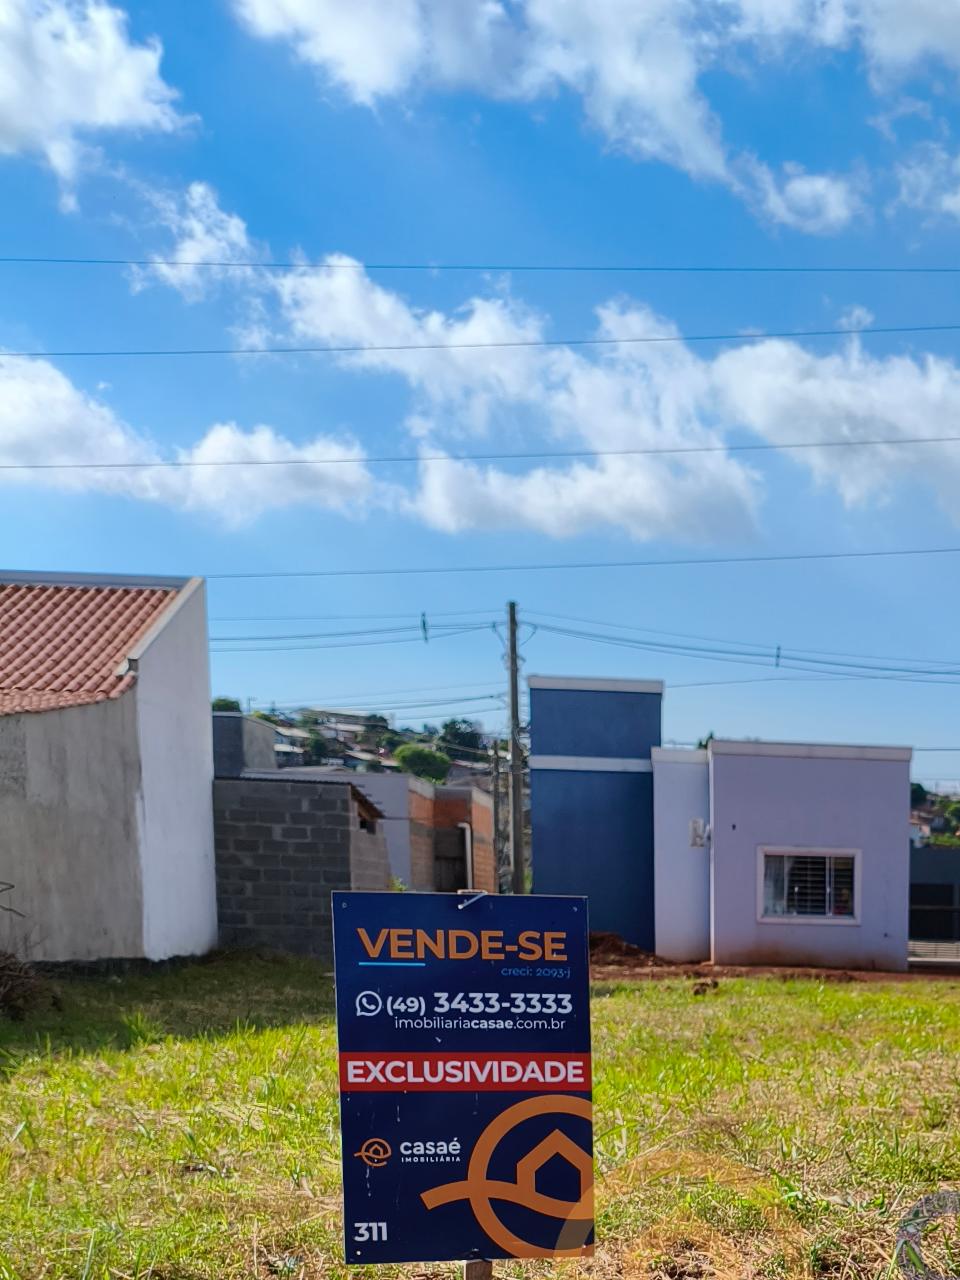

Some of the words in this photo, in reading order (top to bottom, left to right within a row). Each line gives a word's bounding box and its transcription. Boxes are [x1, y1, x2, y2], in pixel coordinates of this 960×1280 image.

[357, 927, 568, 961] VENDE-SE
[386, 996, 426, 1016] (49)
[433, 992, 573, 1014] 3433-3333
[394, 1016, 566, 1030] imobiliariacasae.com.br
[347, 1060, 585, 1083] EXCLUSIVIDADE
[400, 1137, 461, 1154] casaé
[353, 1222, 388, 1242] 311
